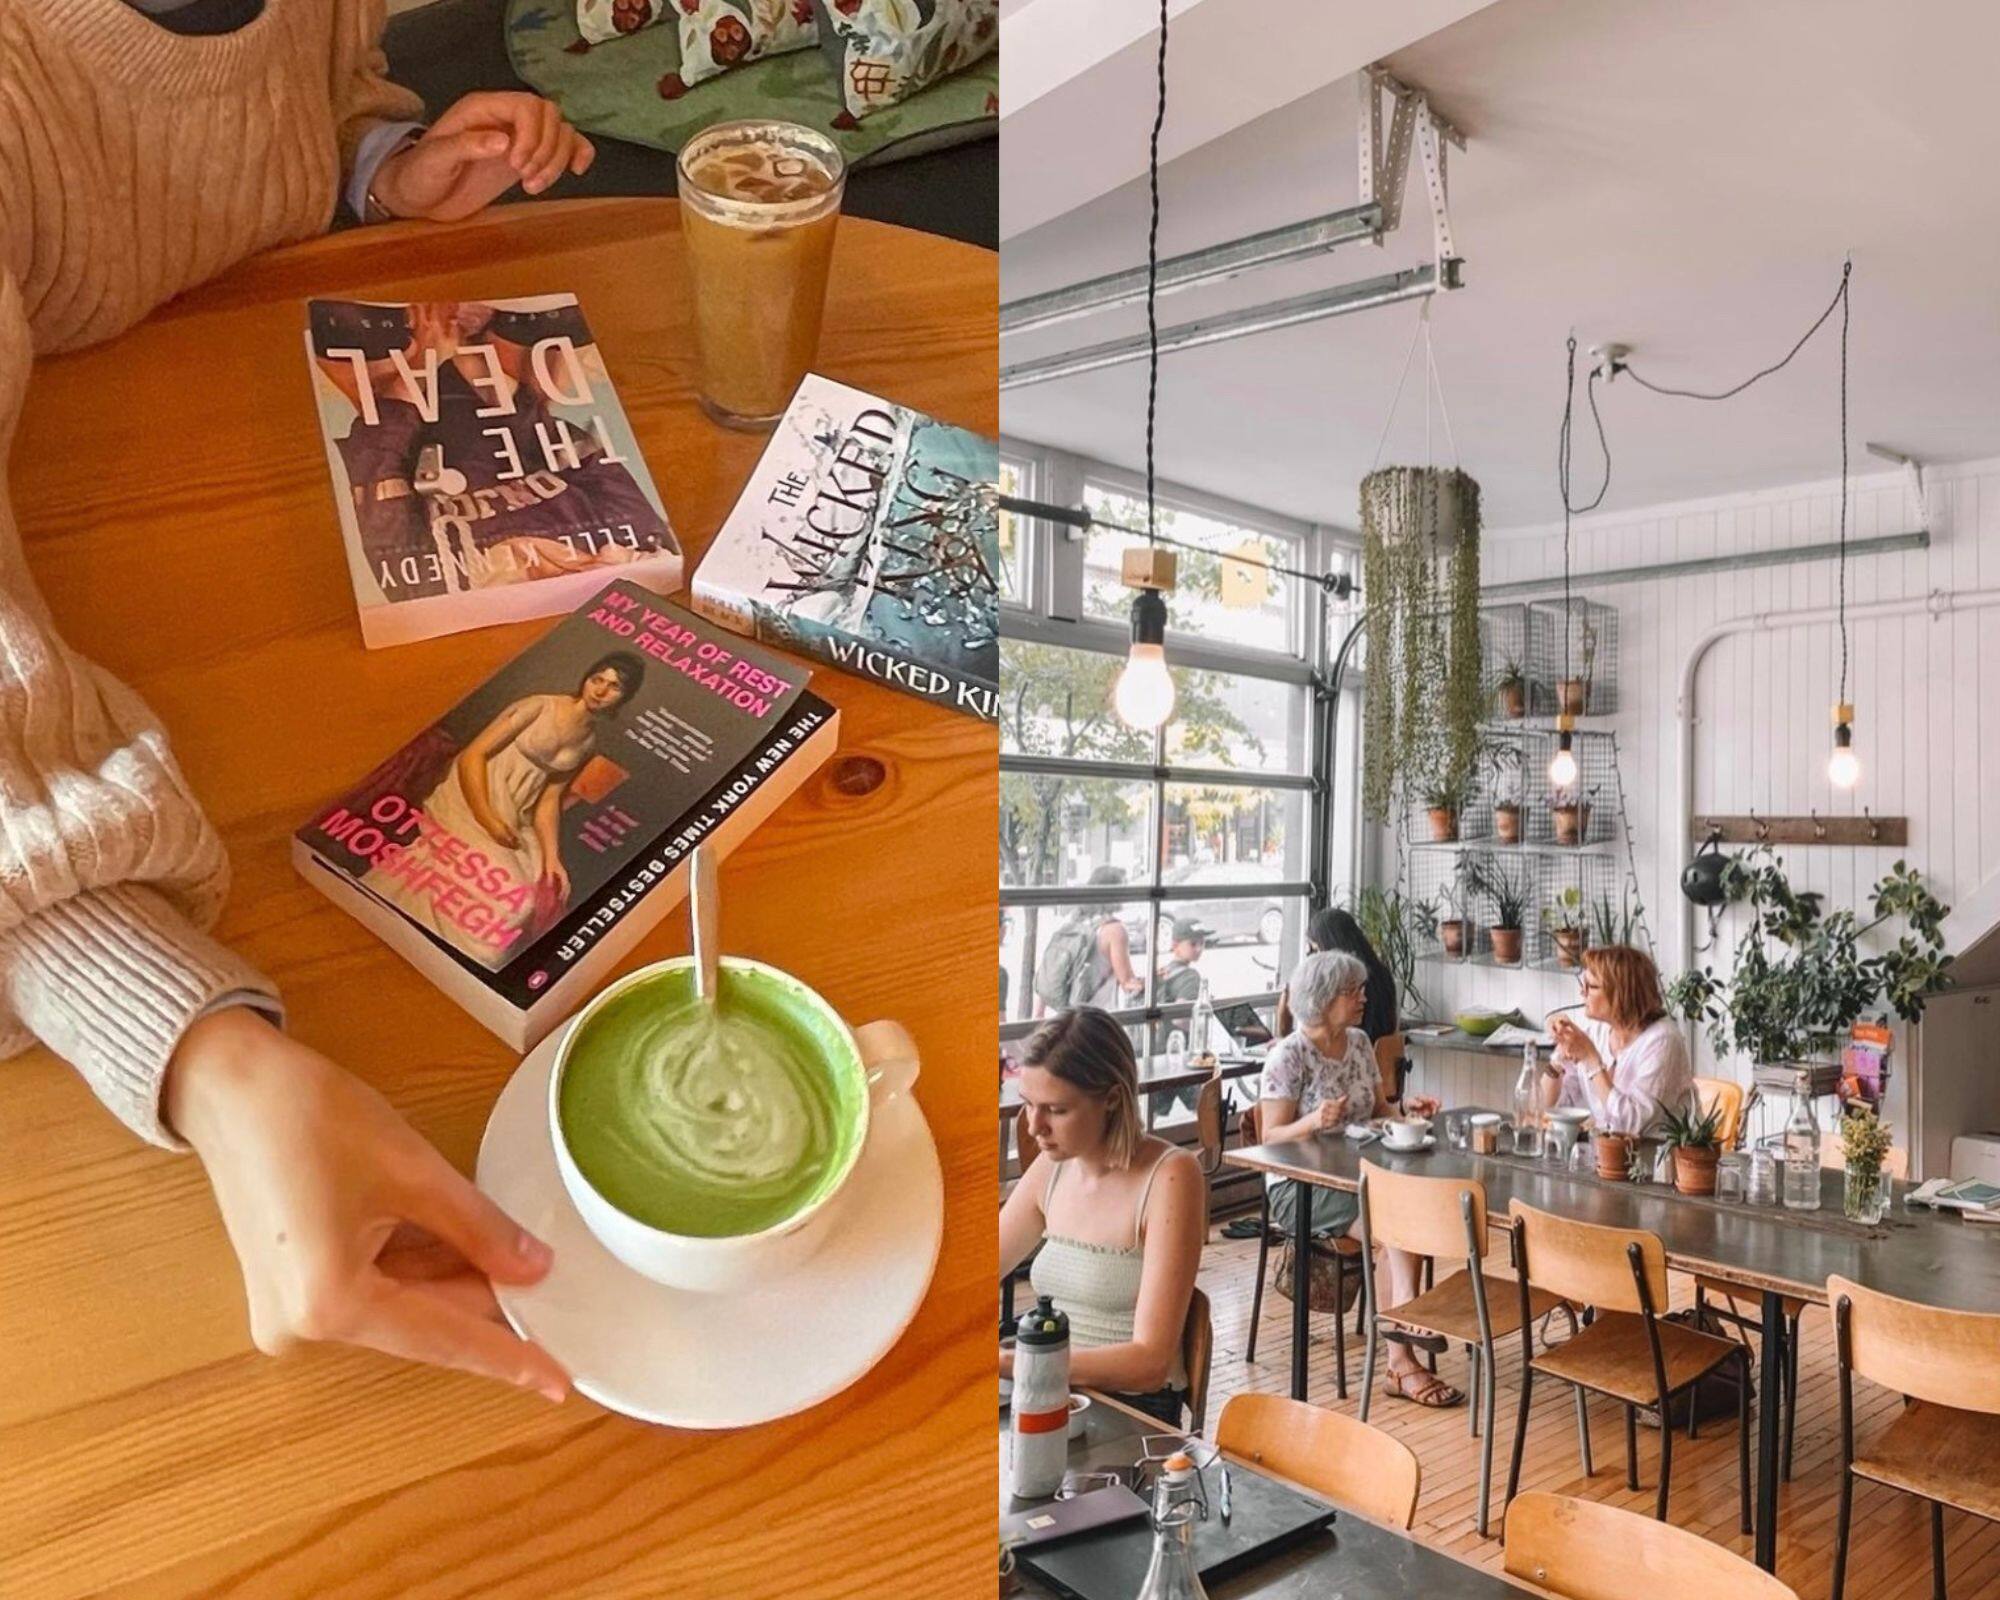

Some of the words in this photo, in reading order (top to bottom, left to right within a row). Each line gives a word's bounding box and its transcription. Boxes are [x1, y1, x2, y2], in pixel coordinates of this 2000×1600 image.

[327, 336, 595, 426] DEAL
[482, 415, 630, 481] THE
[761, 408, 898, 592] WICKED
[767, 471, 809, 508] THE
[557, 524, 639, 562] ELLE
[587, 607, 636, 637] AND
[633, 632, 774, 719] RELAXATION
[603, 591, 640, 613] MY
[639, 608, 698, 648] YEAR
[697, 643, 732, 665] OF
[729, 660, 792, 700] REST
[826, 636, 951, 696] WICKED
[754, 738, 793, 774] NEW
[788, 712, 823, 740] THE
[711, 773, 760, 814] YORK
[370, 795, 534, 915] OTTESSA
[664, 813, 716, 861] TIMES
[319, 808, 523, 950] MOSHFEGH
[556, 858, 666, 962] BESTSELLER
